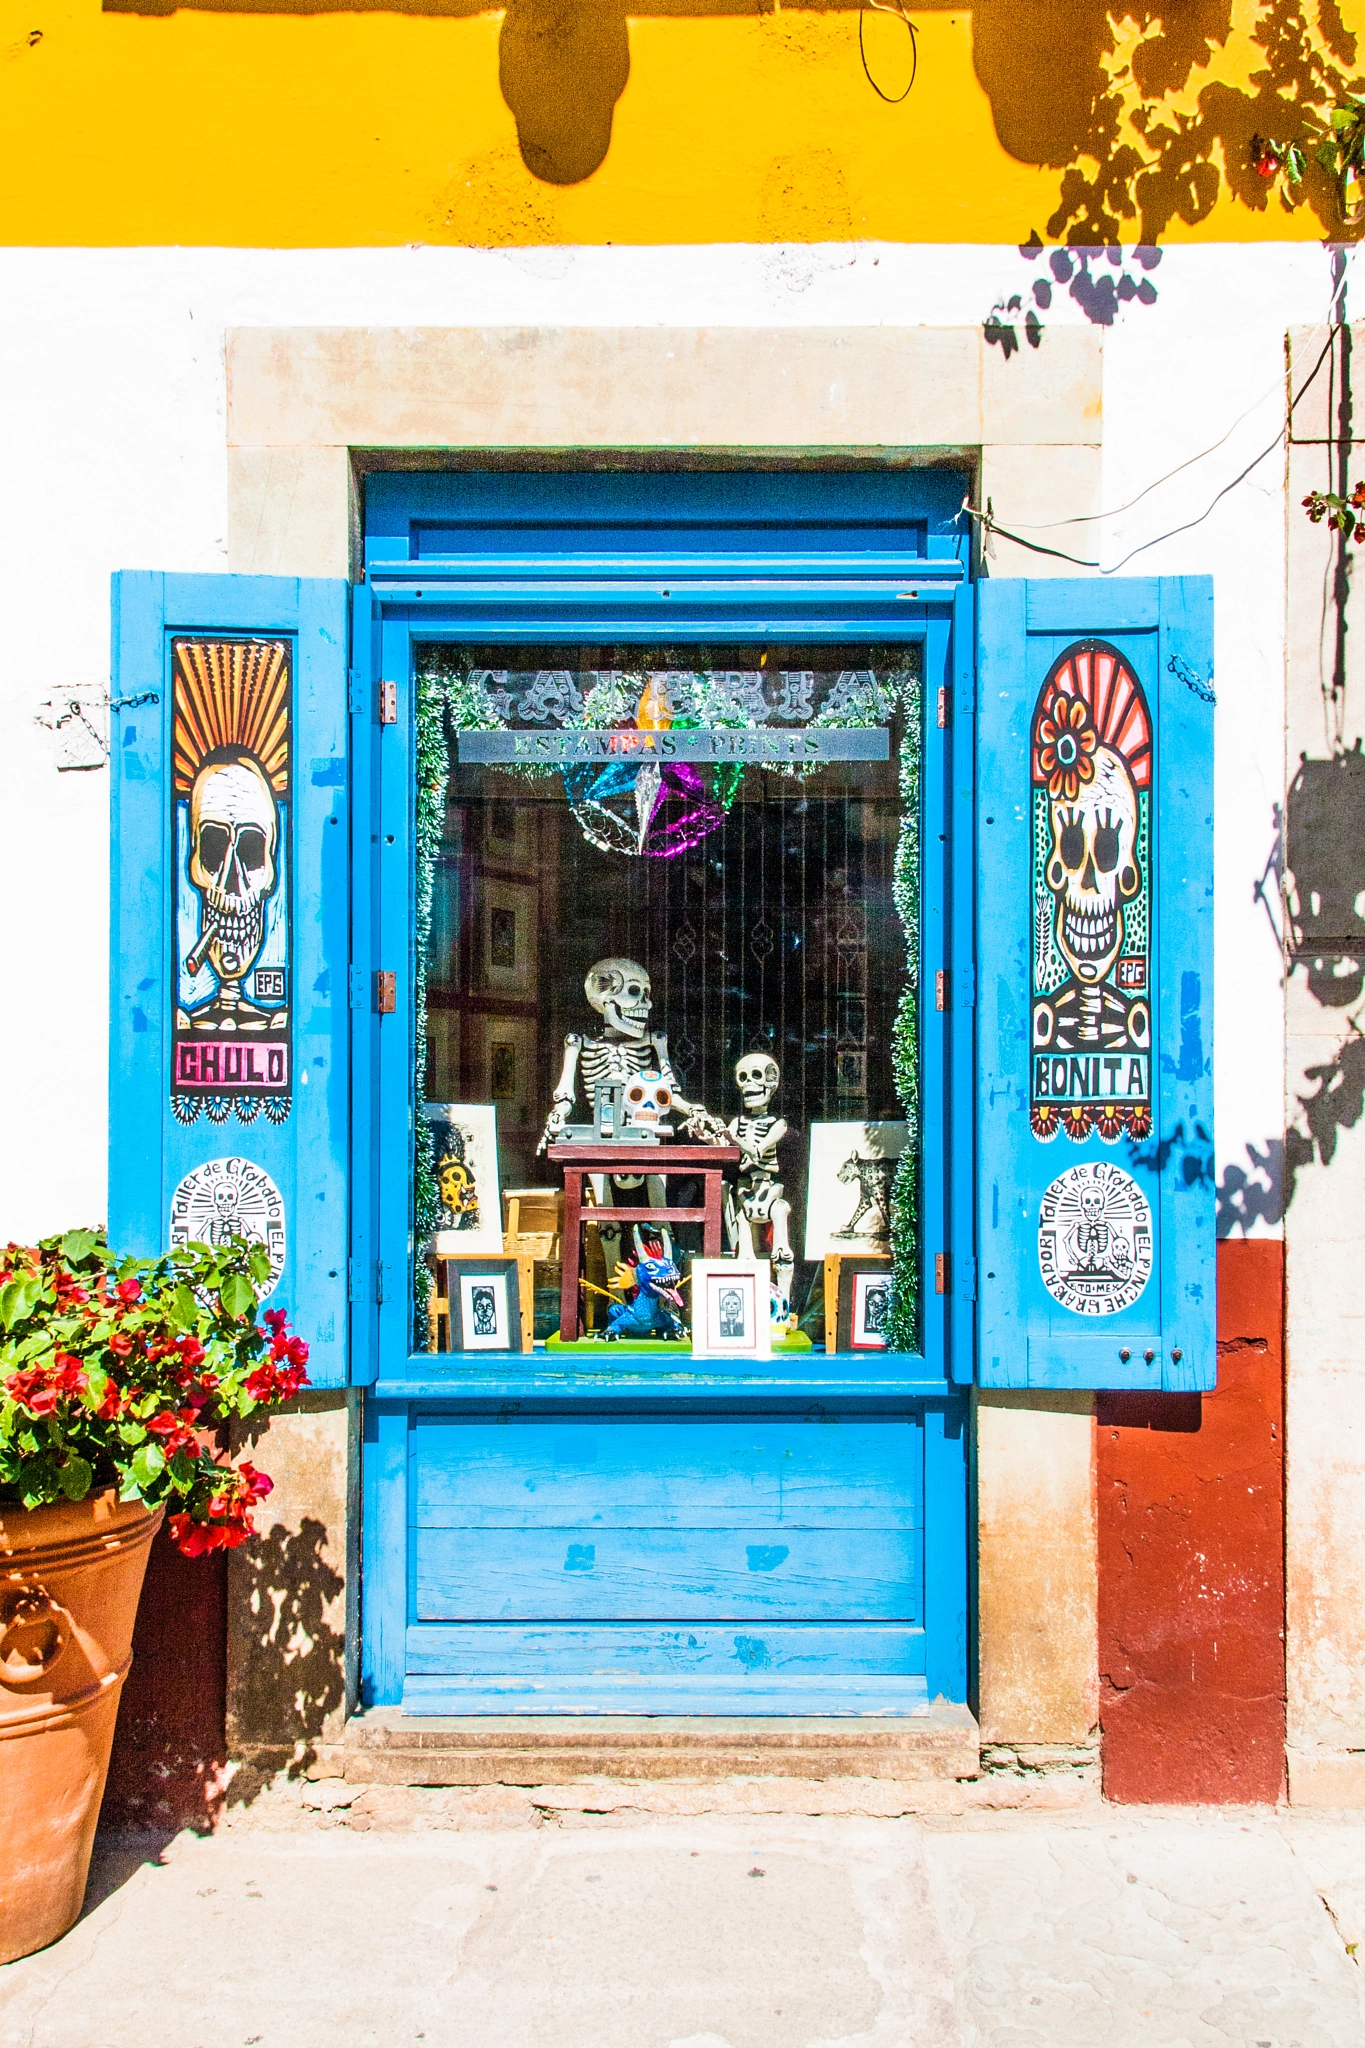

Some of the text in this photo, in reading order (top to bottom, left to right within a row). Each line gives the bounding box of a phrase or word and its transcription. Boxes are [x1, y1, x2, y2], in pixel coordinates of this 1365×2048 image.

[514, 733, 820, 756] ESTAMPAS PRINTS
[180, 1045, 284, 1083] CHULO
[1036, 1057, 1145, 1097] BONITA
[171, 1157, 283, 1225] Taller de Grabado
[1038, 1161, 1149, 1229] Taller de Grabado
